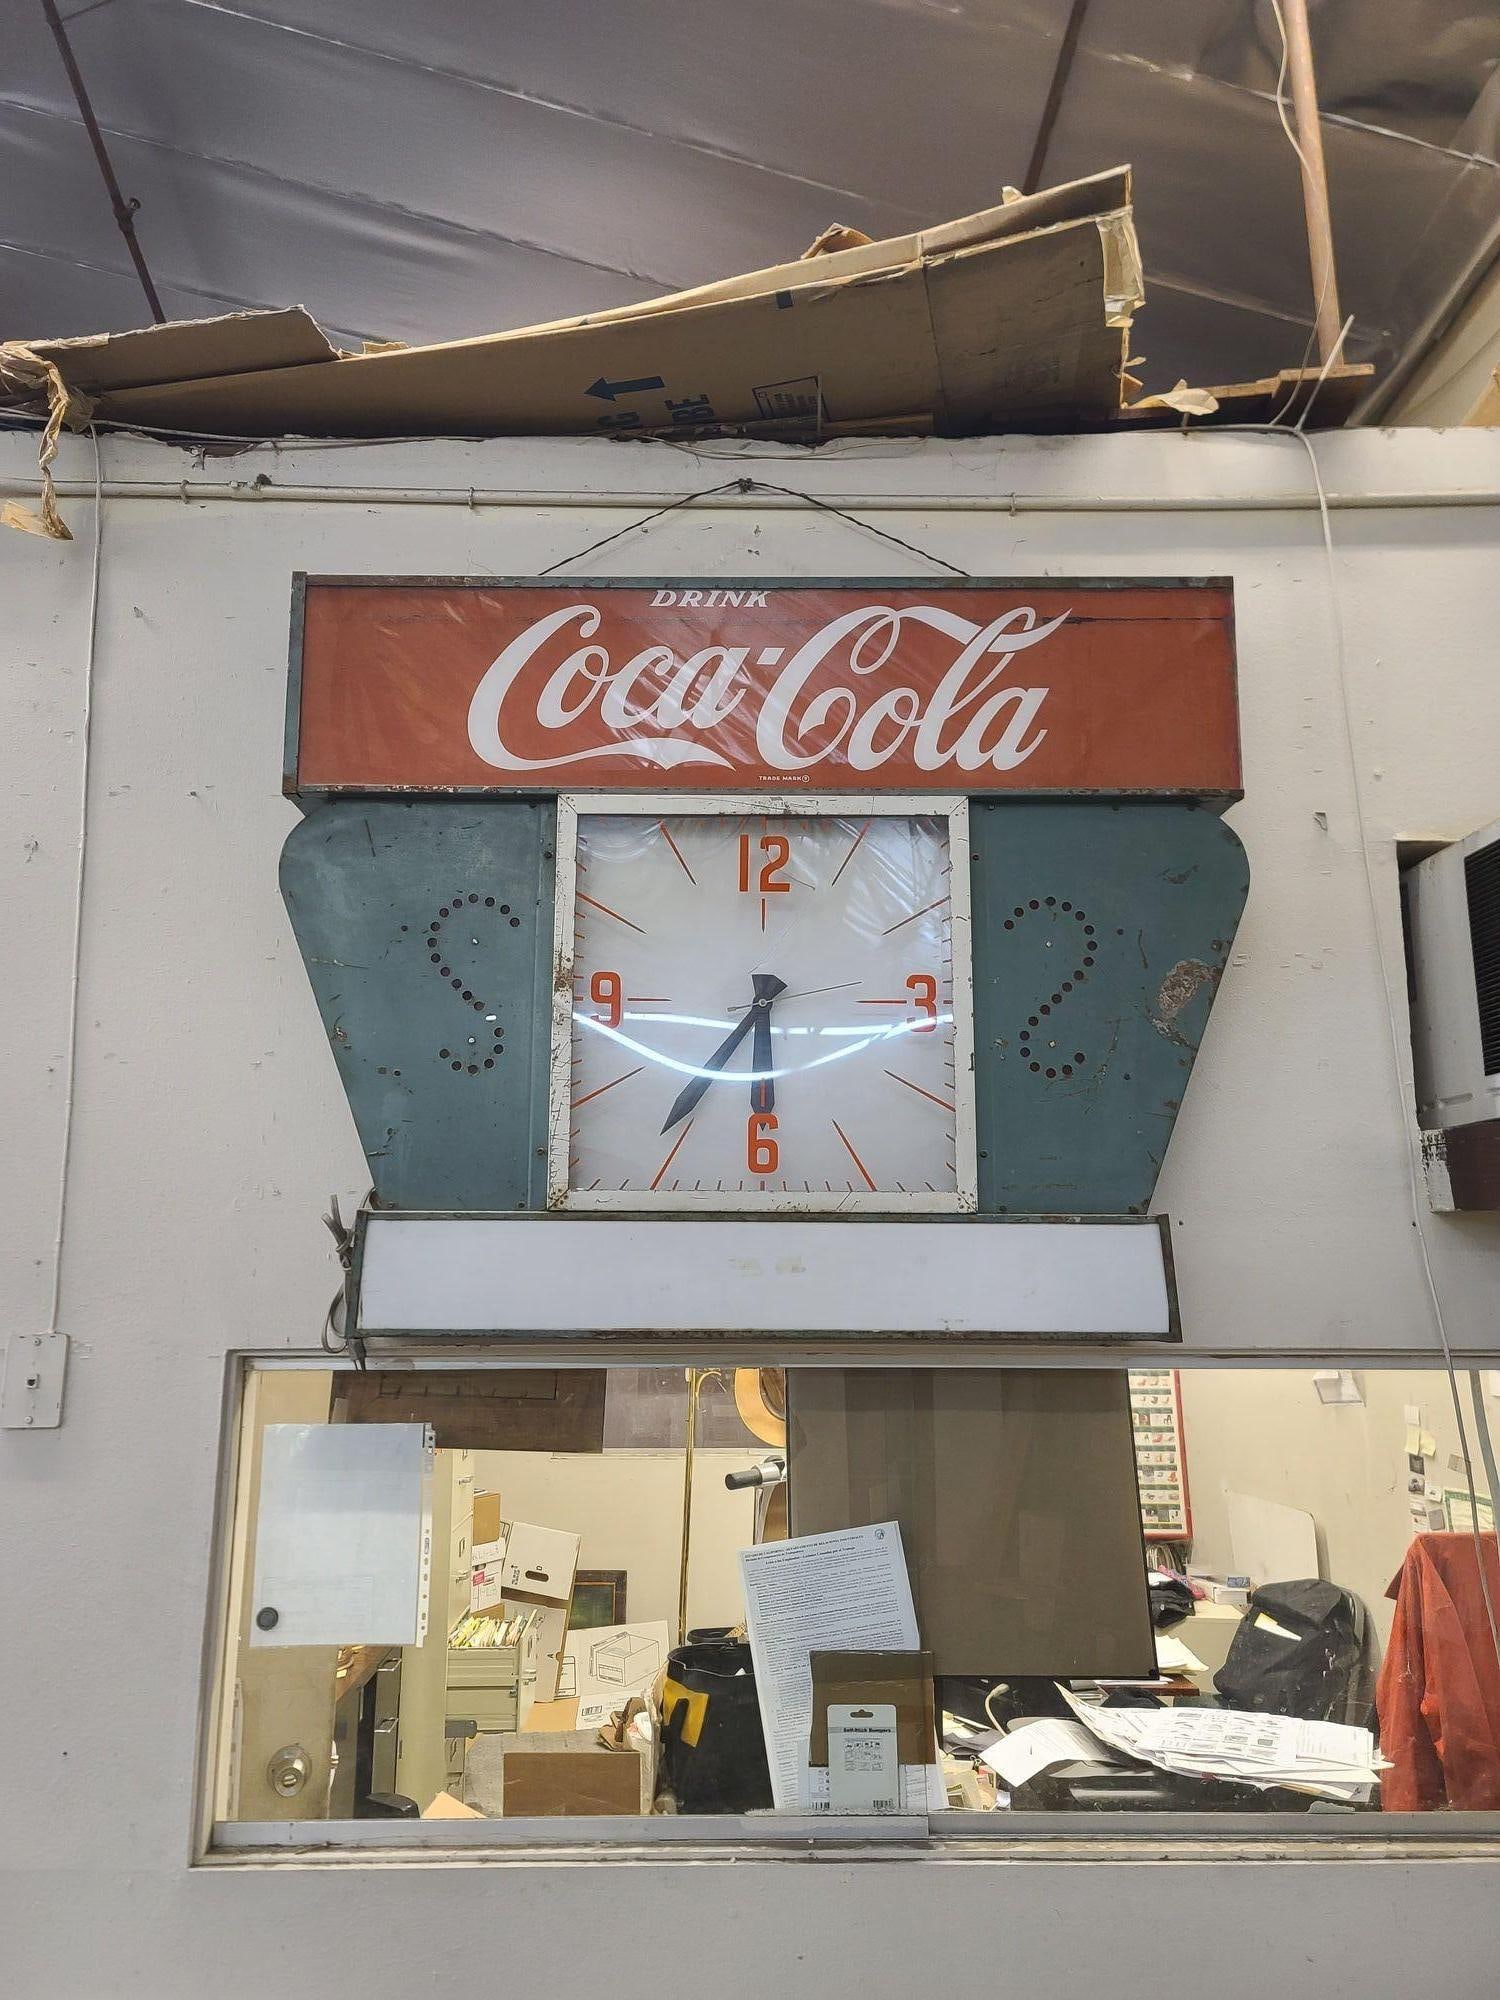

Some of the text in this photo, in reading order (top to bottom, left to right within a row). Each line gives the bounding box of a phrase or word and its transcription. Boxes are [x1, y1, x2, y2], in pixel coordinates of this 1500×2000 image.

[649, 589, 771, 608] DRINK
[467, 604, 1073, 772] Coca-Cola
[737, 834, 791, 893] 12
[590, 971, 622, 1029] 9
[906, 974, 937, 1032] 3
[747, 1112, 779, 1174] 6
